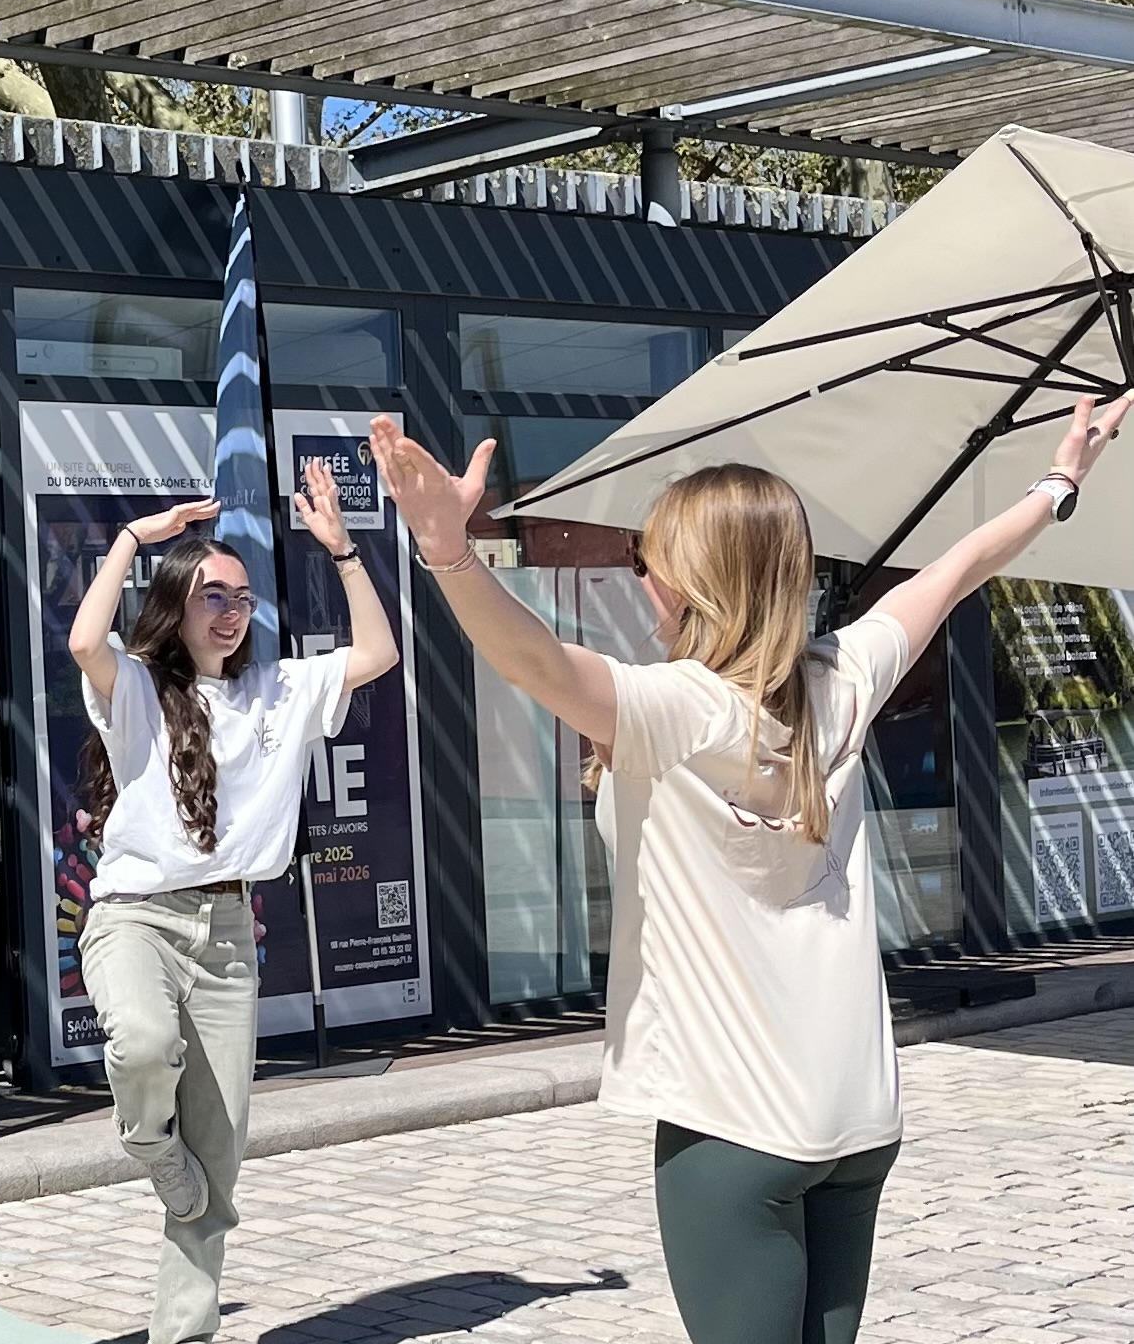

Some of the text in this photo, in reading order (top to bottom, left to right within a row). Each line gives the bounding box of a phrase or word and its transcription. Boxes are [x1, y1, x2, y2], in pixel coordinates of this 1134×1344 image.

[47, 462, 135, 474] UN SITE CULTUREL
[47, 476, 62, 487] DU
[64, 474, 136, 488] DÉPARTEMENT
[138, 477, 152, 488] DE
[360, 473, 371, 484] du
[348, 496, 372, 509] nage
[332, 821, 369, 835] SAVOIRS
[324, 845, 354, 862] 2025
[314, 864, 370, 885] mai 2026
[67, 1016, 97, 1033] SAÔN
